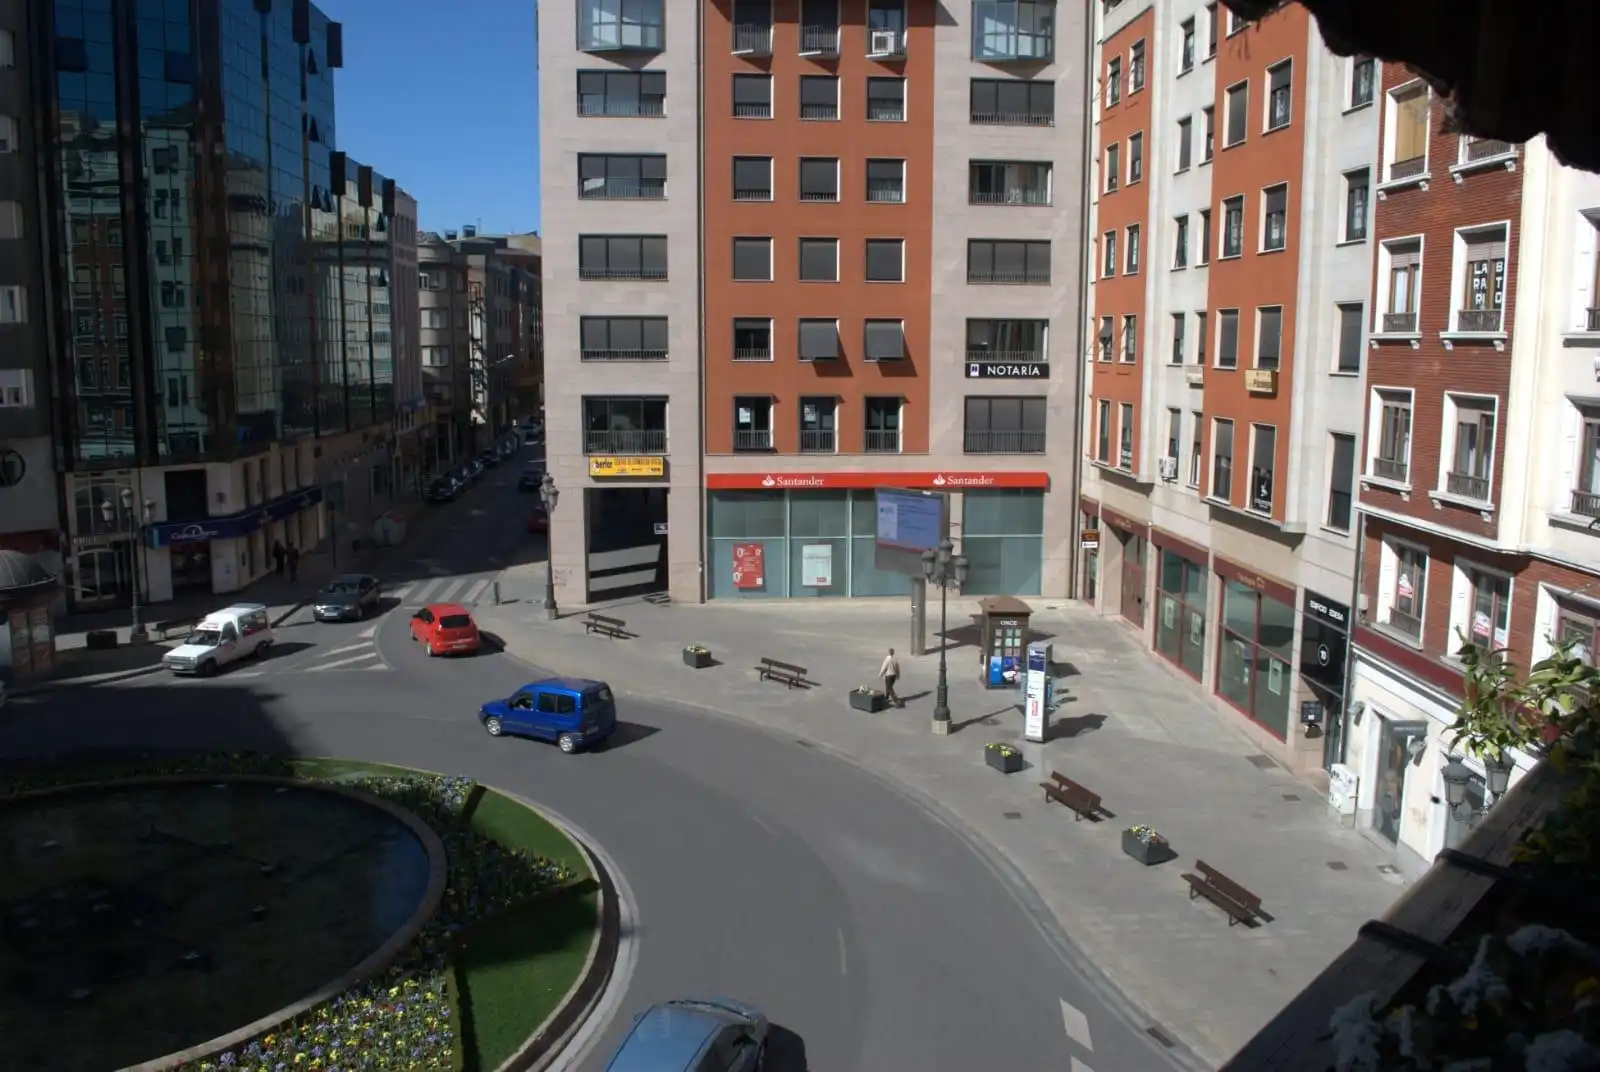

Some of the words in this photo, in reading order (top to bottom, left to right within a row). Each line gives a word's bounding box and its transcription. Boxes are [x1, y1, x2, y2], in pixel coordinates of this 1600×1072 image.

[987, 364, 1041, 376] NOTARÍA
[776, 475, 825, 487] Santander
[947, 475, 995, 486] Santander
